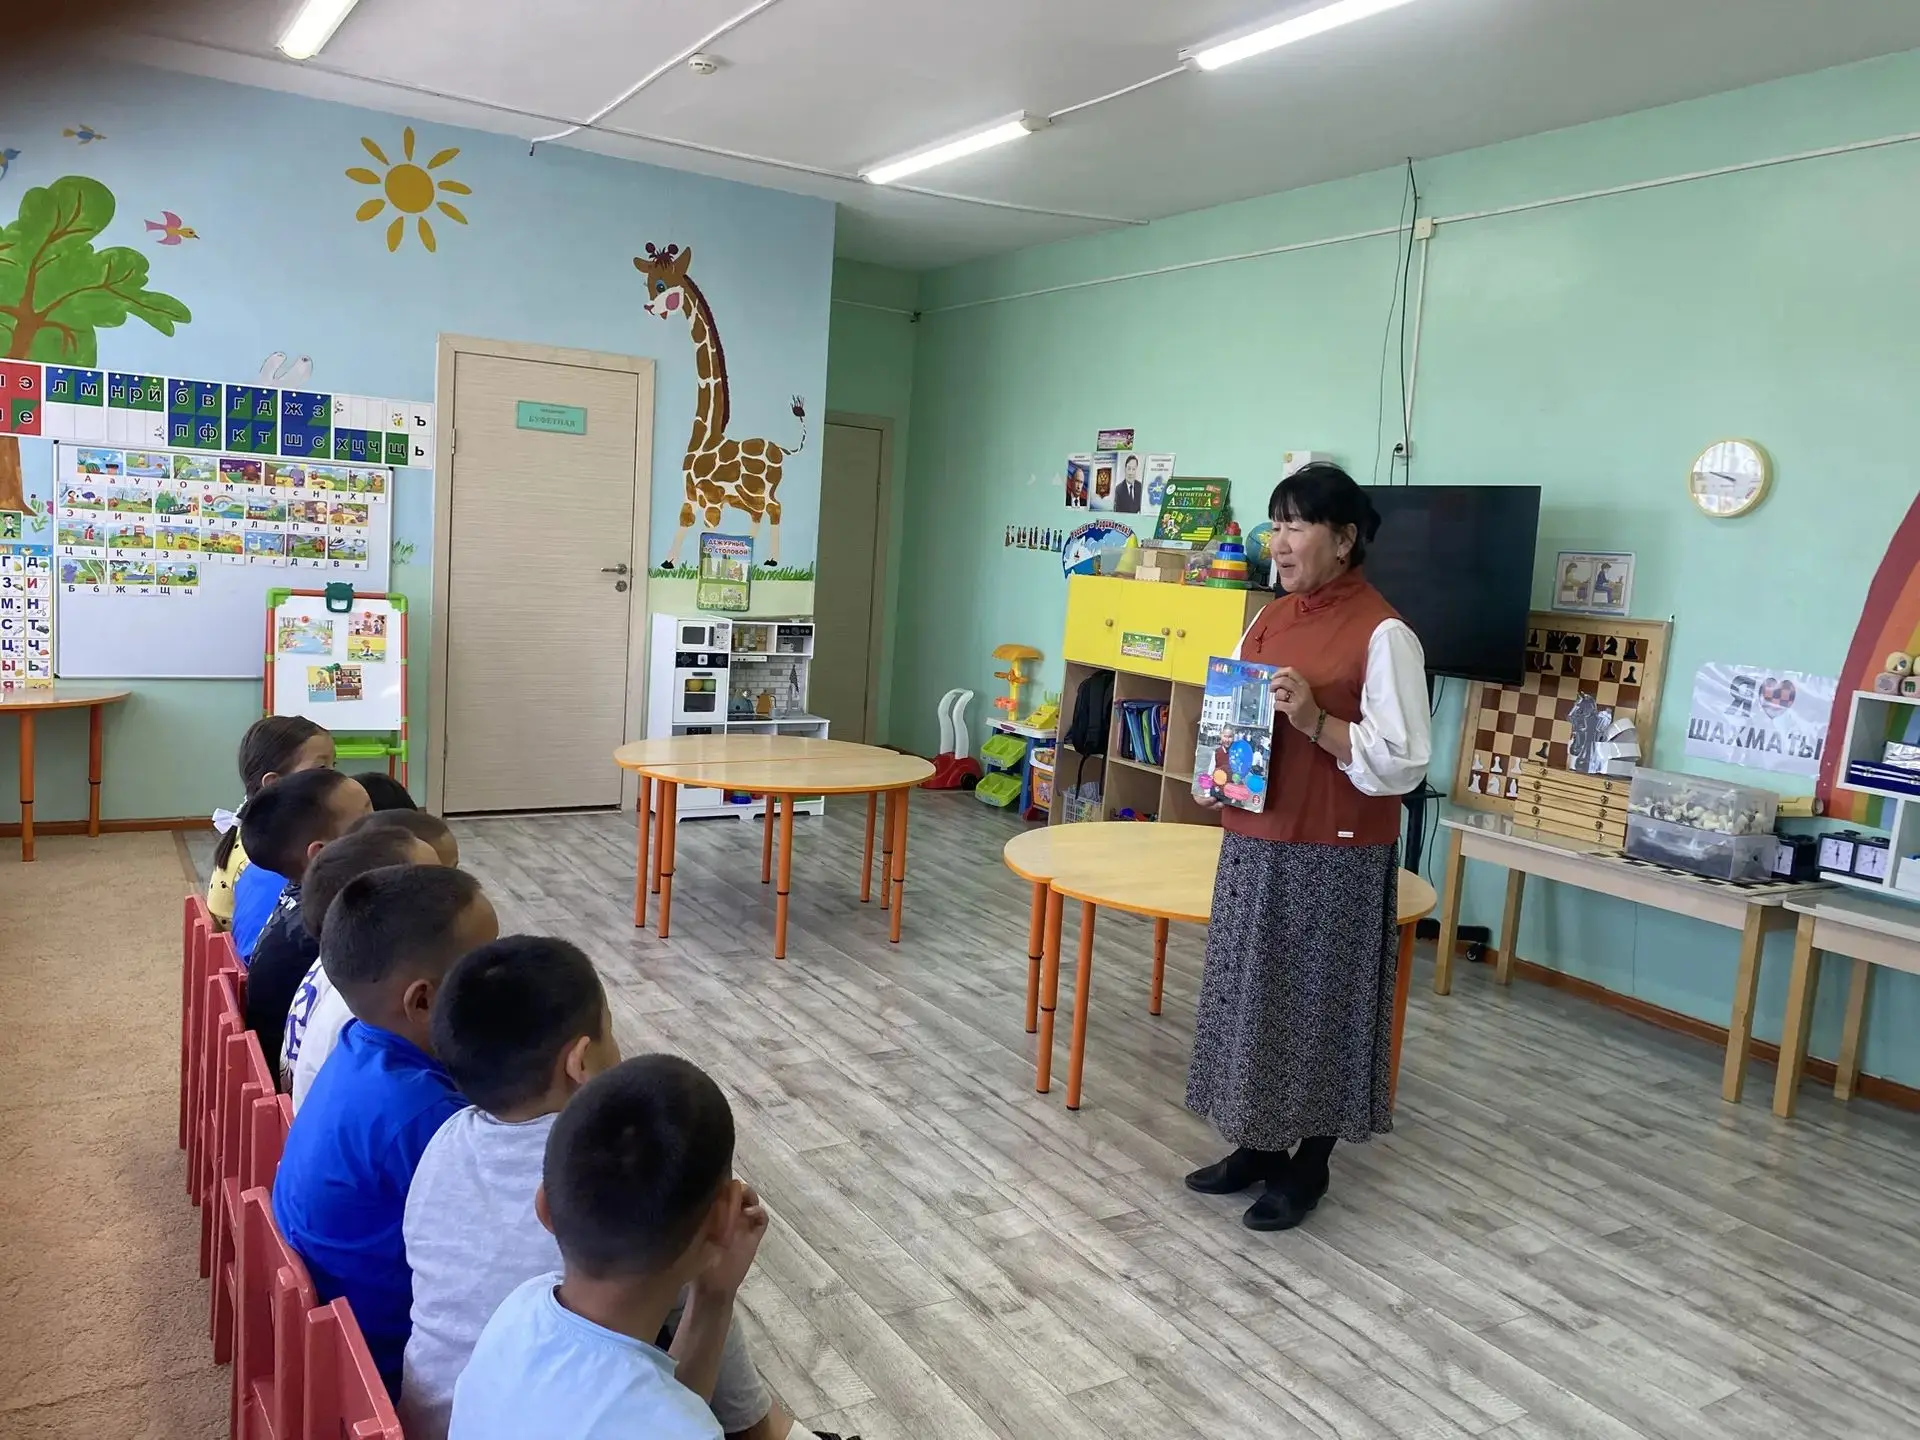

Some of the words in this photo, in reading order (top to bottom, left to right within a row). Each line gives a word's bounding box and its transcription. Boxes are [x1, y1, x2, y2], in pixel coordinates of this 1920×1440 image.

[19, 376, 33, 390] э
[53, 380, 67, 394] л
[81, 382, 97, 396] м
[111, 386, 124, 398] н
[130, 387, 143, 403] р
[148, 385, 161, 402] й
[176, 388, 189, 405] б
[202, 394, 215, 407] в
[234, 397, 245, 409] г
[257, 400, 272, 415] д
[285, 402, 303, 416] ж
[312, 405, 324, 417] з
[20, 411, 33, 424] е
[414, 416, 426, 427] ъ
[175, 424, 188, 437] п
[199, 423, 218, 443] ф
[233, 429, 246, 442] к
[259, 432, 270, 444] т
[285, 434, 302, 446] ш
[312, 436, 325, 448] с
[336, 438, 348, 450] х
[352, 440, 365, 454] ц
[368, 440, 380, 453] ч
[388, 443, 406, 457] щ
[415, 446, 424, 456] ь
[1168, 497, 1212, 507] АЗБУКА
[2, 556, 10, 566] Г
[27, 557, 38, 567] Д
[3, 577, 12, 588] З
[27, 578, 37, 588] И
[2, 598, 13, 609] М
[28, 599, 38, 609] Н
[2, 619, 12, 629] С
[28, 620, 38, 629] Т
[2, 640, 13, 652] Ц
[28, 640, 39, 650] Ч
[2, 660, 15, 671] Ы
[29, 661, 39, 671] Ь
[1724, 675, 1756, 717] Я
[1688, 718, 1824, 760] ШАХМАТЫ
